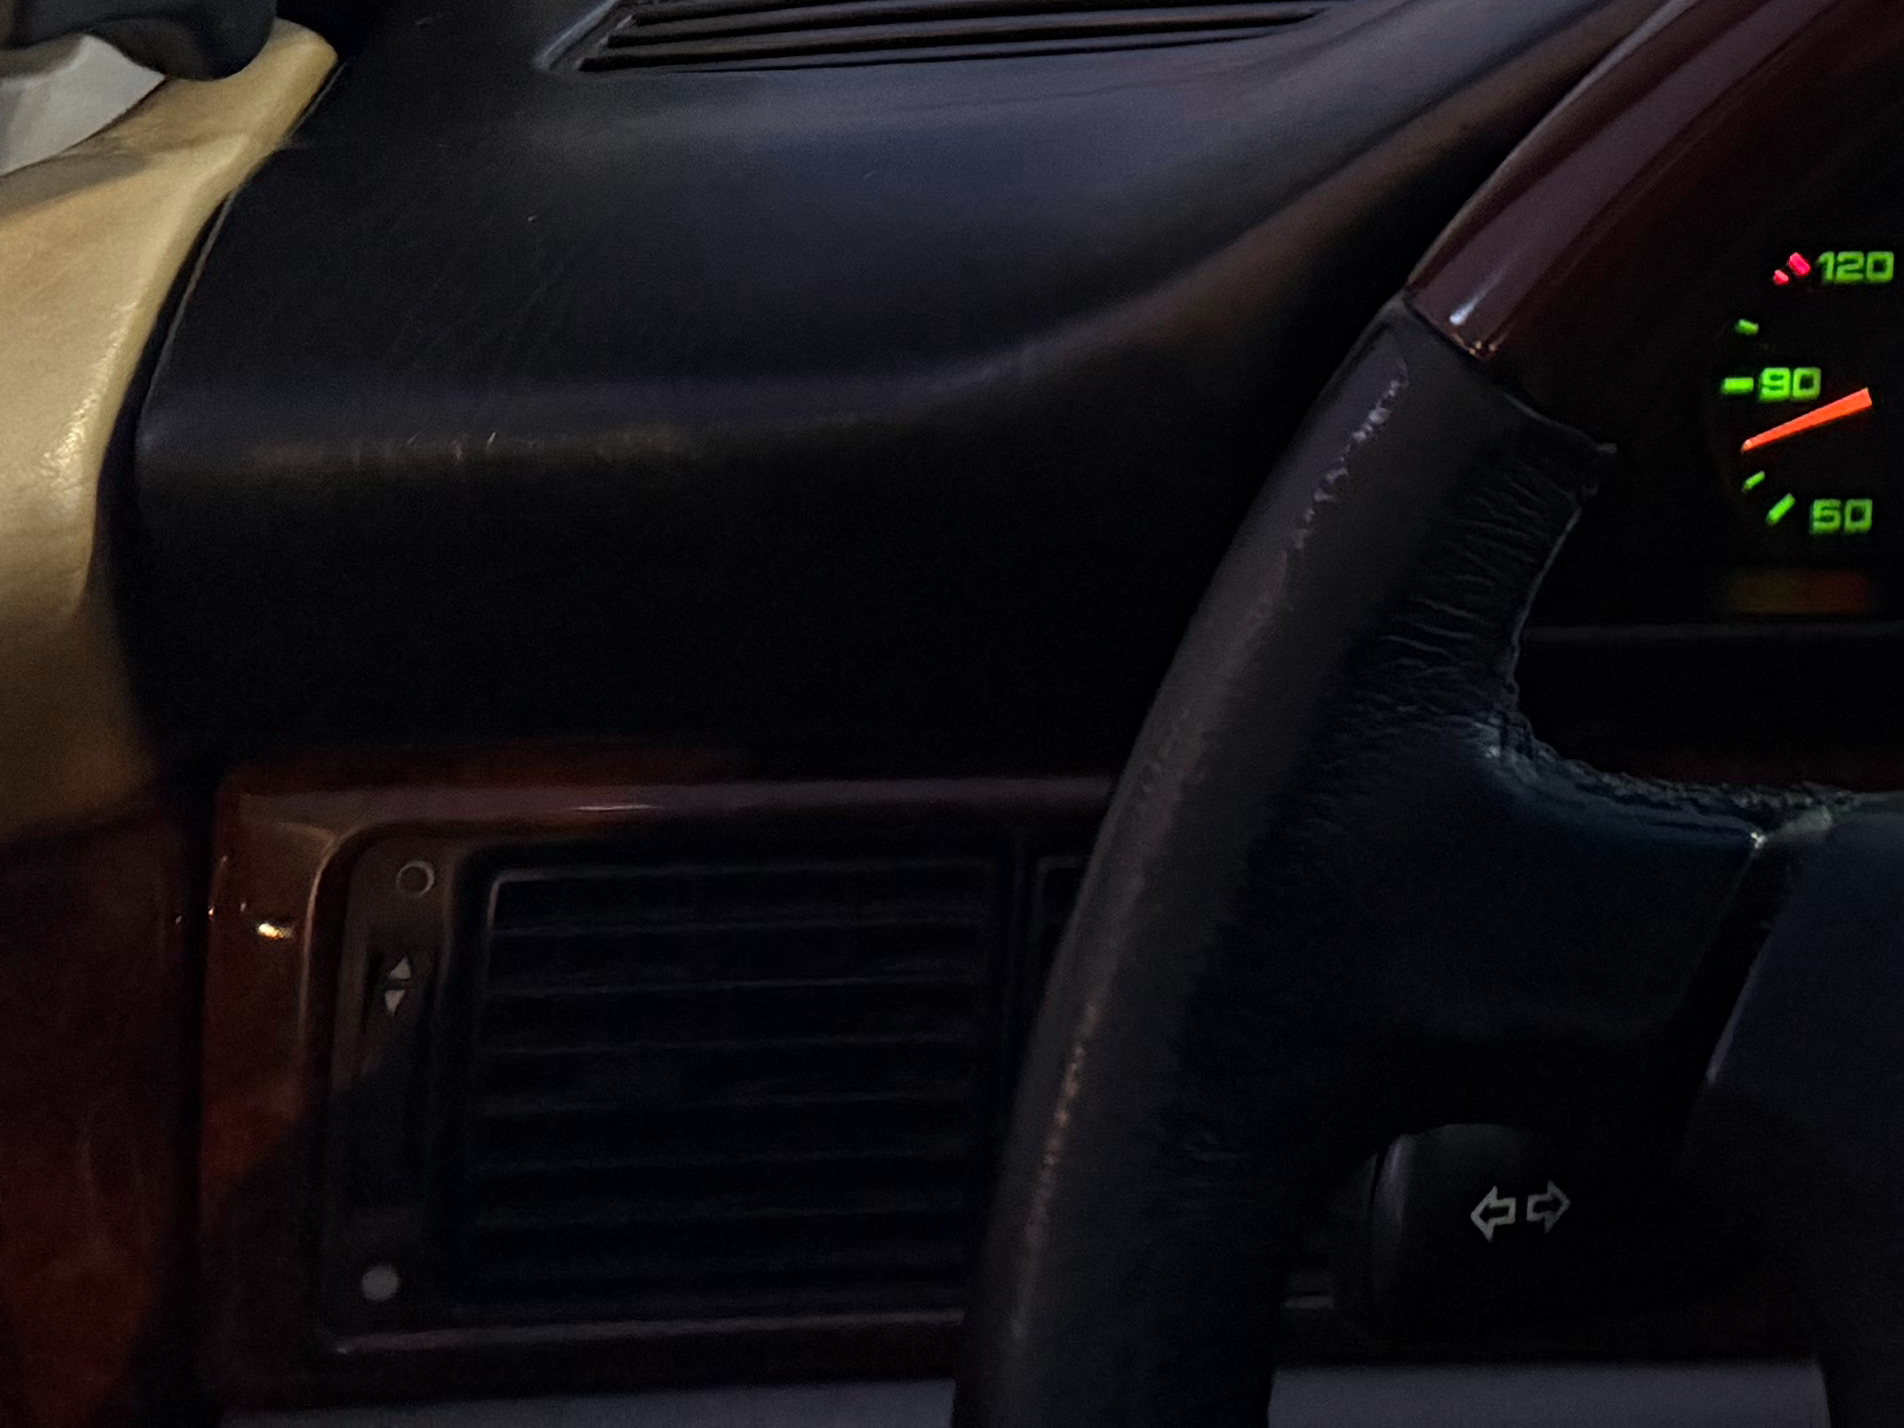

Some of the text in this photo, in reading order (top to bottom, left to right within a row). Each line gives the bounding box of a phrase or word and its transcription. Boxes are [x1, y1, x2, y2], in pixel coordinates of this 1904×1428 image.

[1818, 250, 1895, 284] 120
[1759, 366, 1821, 401] 90
[1810, 497, 1873, 533] 50
